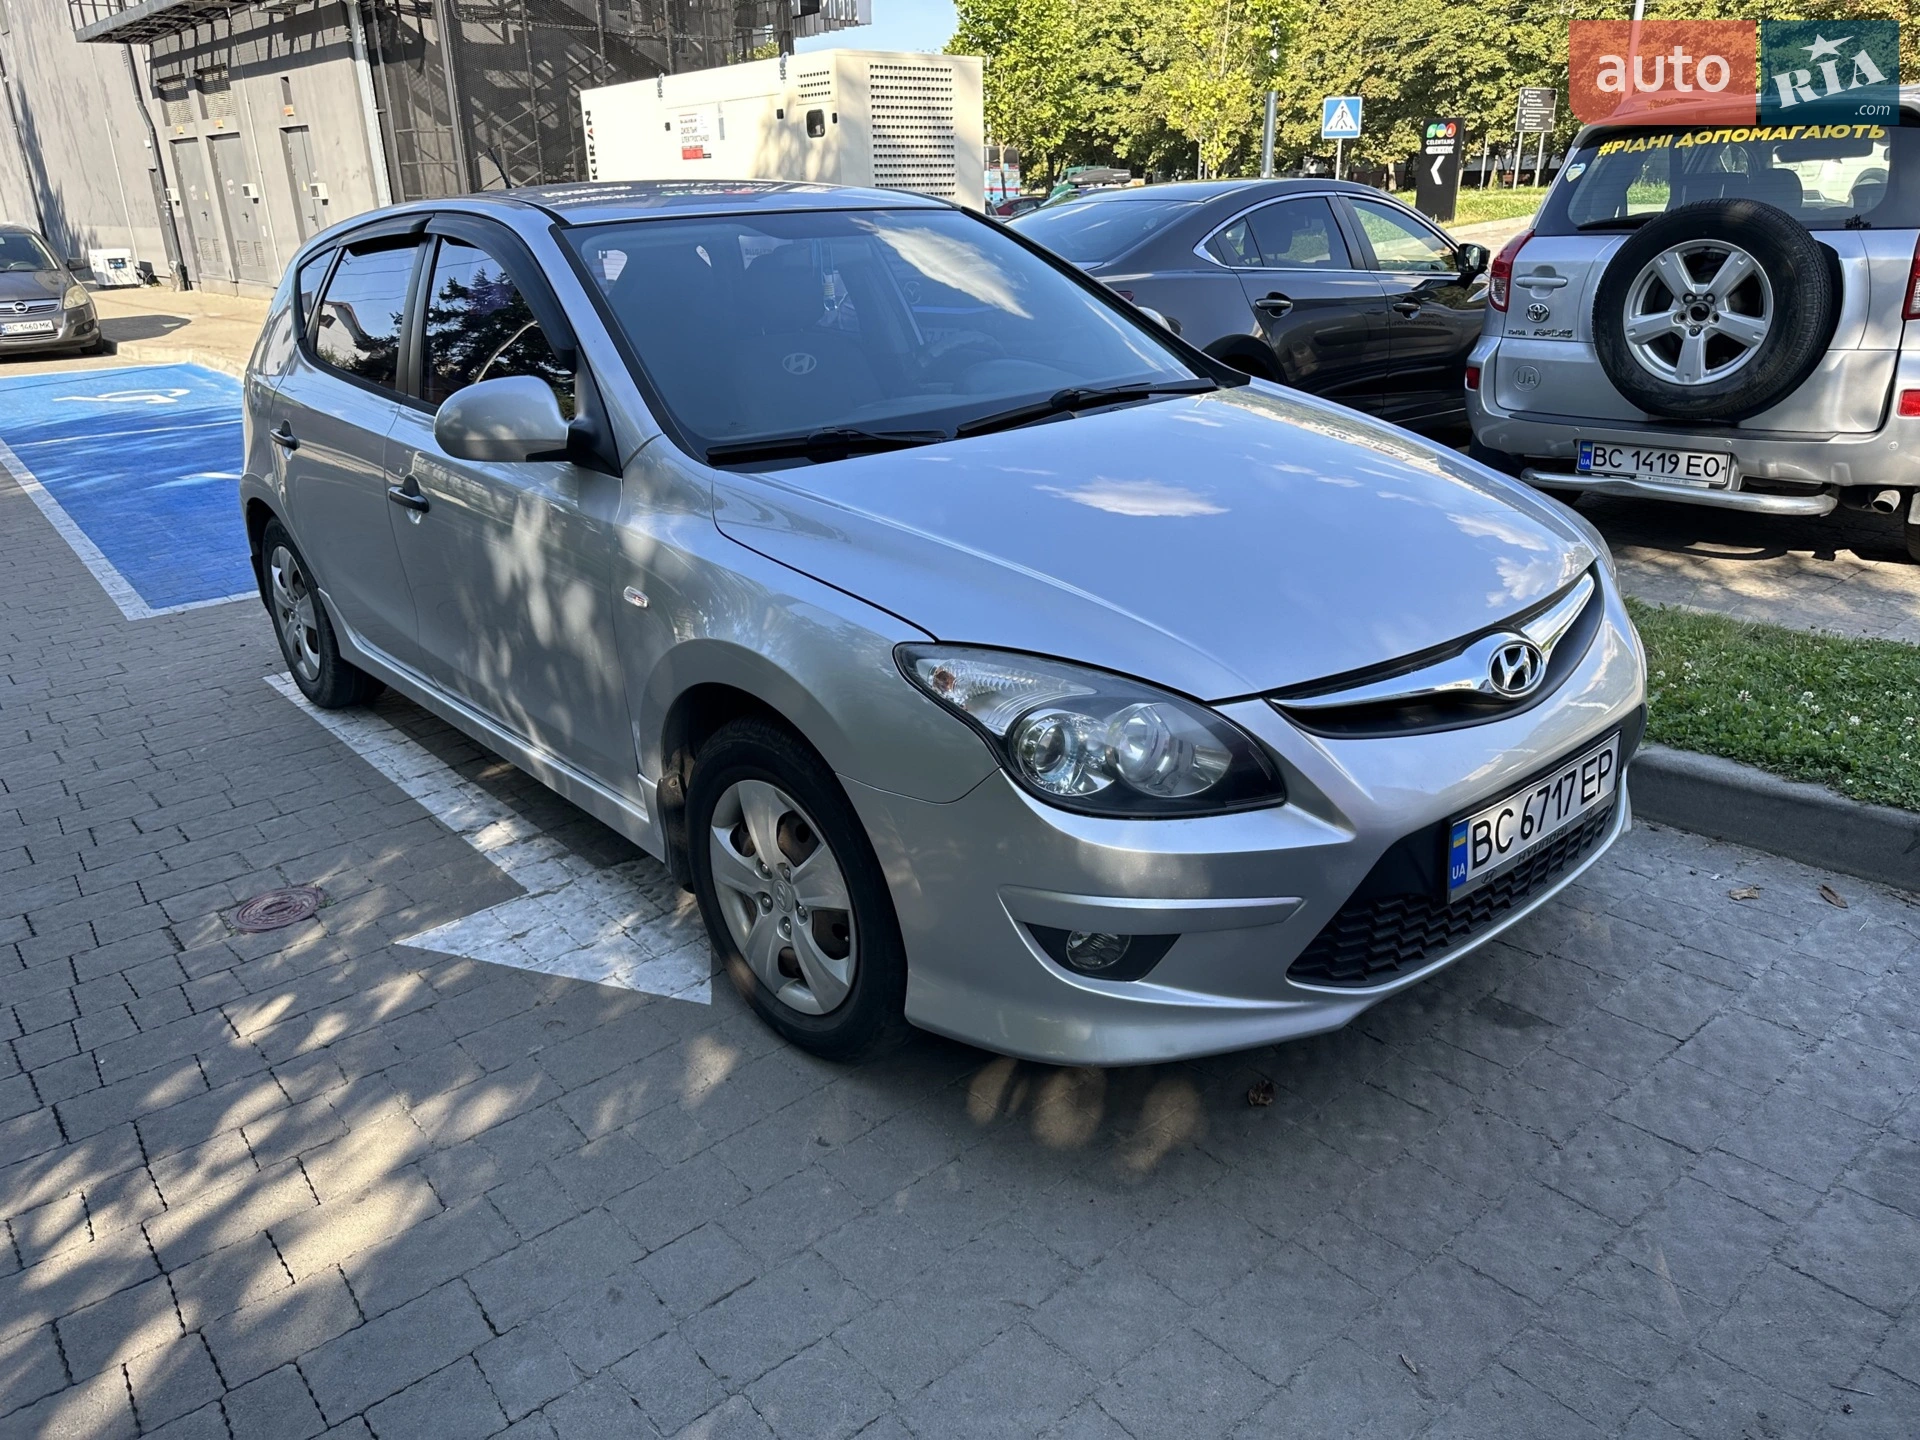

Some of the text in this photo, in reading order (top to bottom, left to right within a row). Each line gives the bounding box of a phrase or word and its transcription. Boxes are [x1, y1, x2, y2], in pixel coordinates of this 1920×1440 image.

[1598, 124, 1887, 157] #РІДНІ ДОПОМАГАЮТЬ
[1517, 371, 1536, 385] UA
[1580, 458, 1590, 466] UA
[1592, 446, 1720, 478] BC 1419 EO
[1472, 748, 1613, 871] BC 6717 EP
[1517, 826, 1567, 864] HYUNDAI
[1452, 862, 1466, 880] UA
